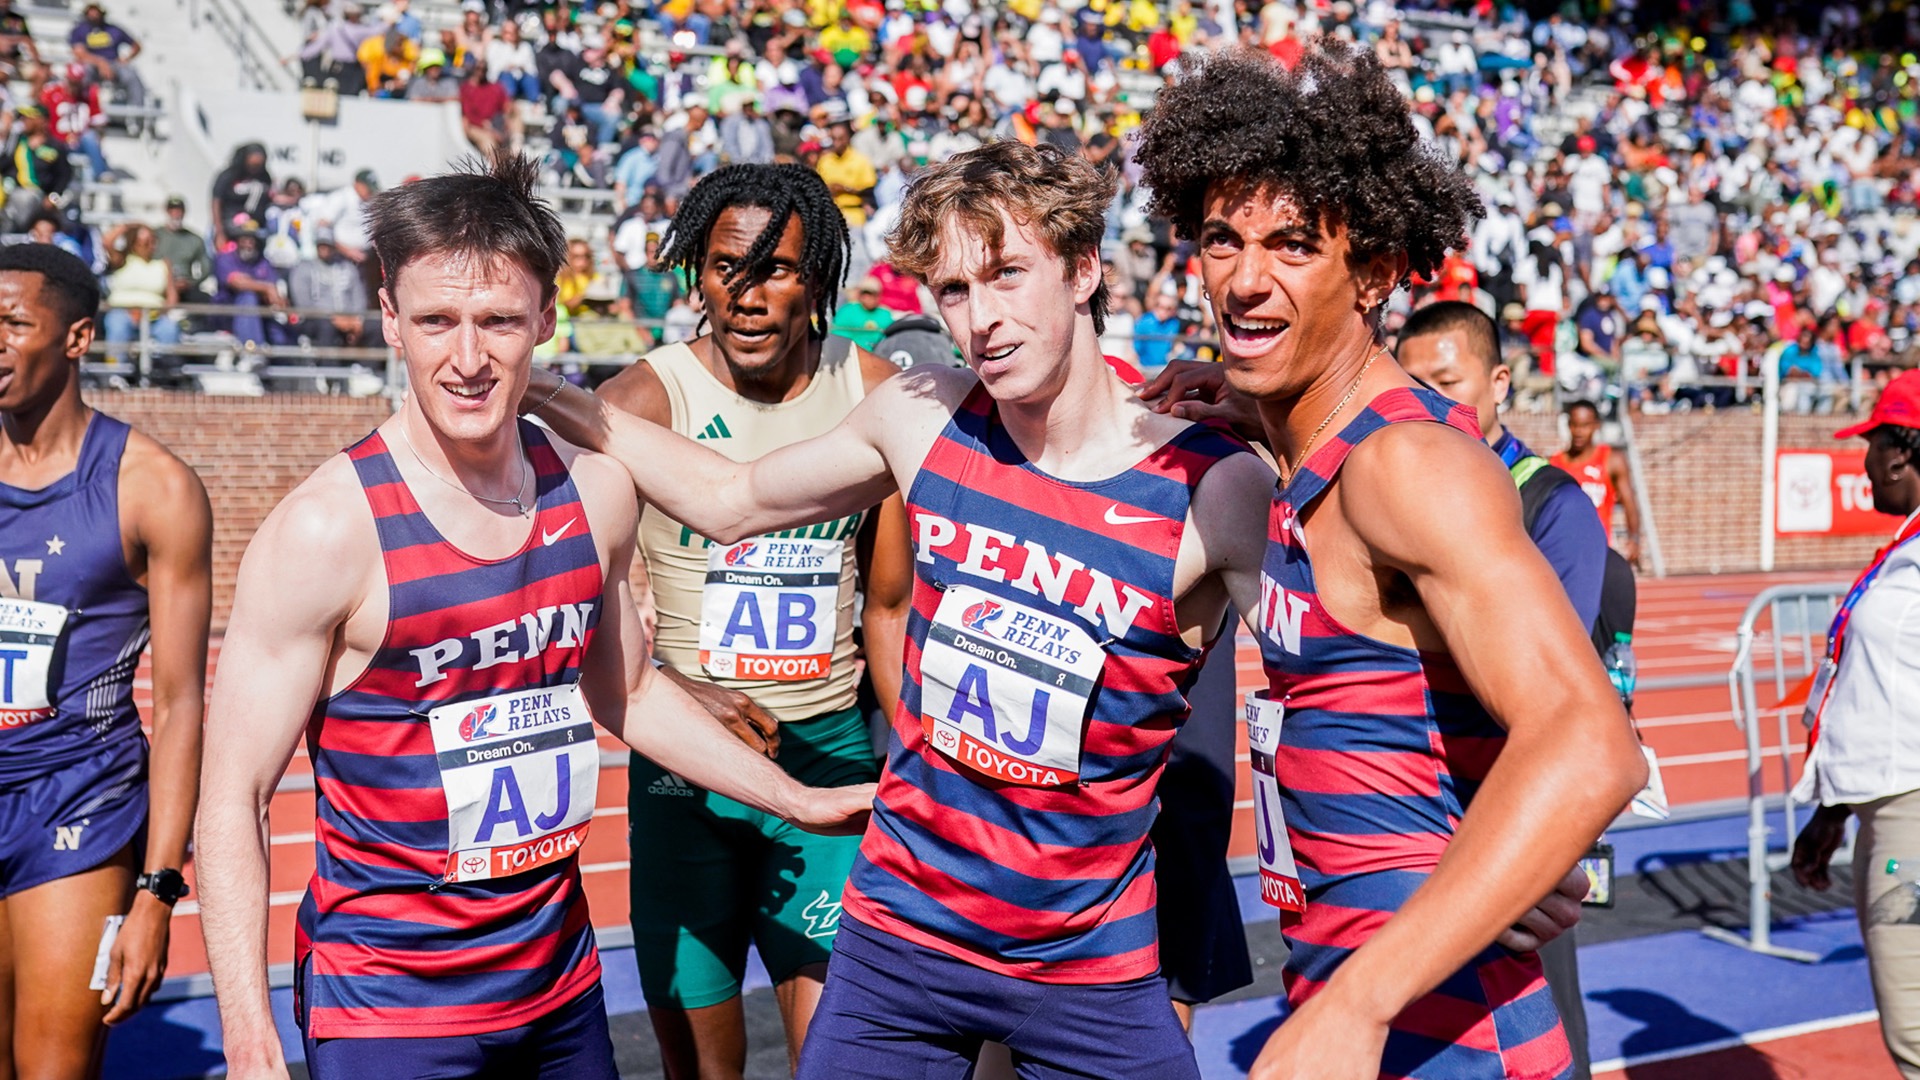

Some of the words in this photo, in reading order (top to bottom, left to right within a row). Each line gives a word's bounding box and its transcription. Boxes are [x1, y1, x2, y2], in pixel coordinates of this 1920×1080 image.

[764, 556, 824, 568] RELAYS
[768, 543, 813, 555] PENN
[725, 572, 762, 585] Dream
[763, 575, 783, 586] On.
[915, 513, 1154, 640] PENN
[0, 603, 36, 616] ENN
[0, 614, 47, 630] ELAYS
[719, 591, 816, 650] AB
[1011, 611, 1070, 642] PENN
[409, 603, 594, 688] PENN
[953, 634, 996, 660] Dream
[996, 651, 1018, 669] On.
[1002, 626, 1081, 665] RELAYS
[741, 658, 820, 674] TOYOTA
[508, 693, 552, 714] PENN
[947, 663, 1050, 756] AJ
[508, 707, 571, 732] RELAYS
[466, 746, 512, 763] Dream
[513, 741, 535, 754] On.
[964, 739, 1061, 785] TOYOTA
[474, 753, 570, 843] AJ
[648, 785, 694, 797] adidas
[54, 826, 83, 851] N
[497, 831, 580, 870] TOYOTA
[1261, 875, 1299, 906] YOTA
